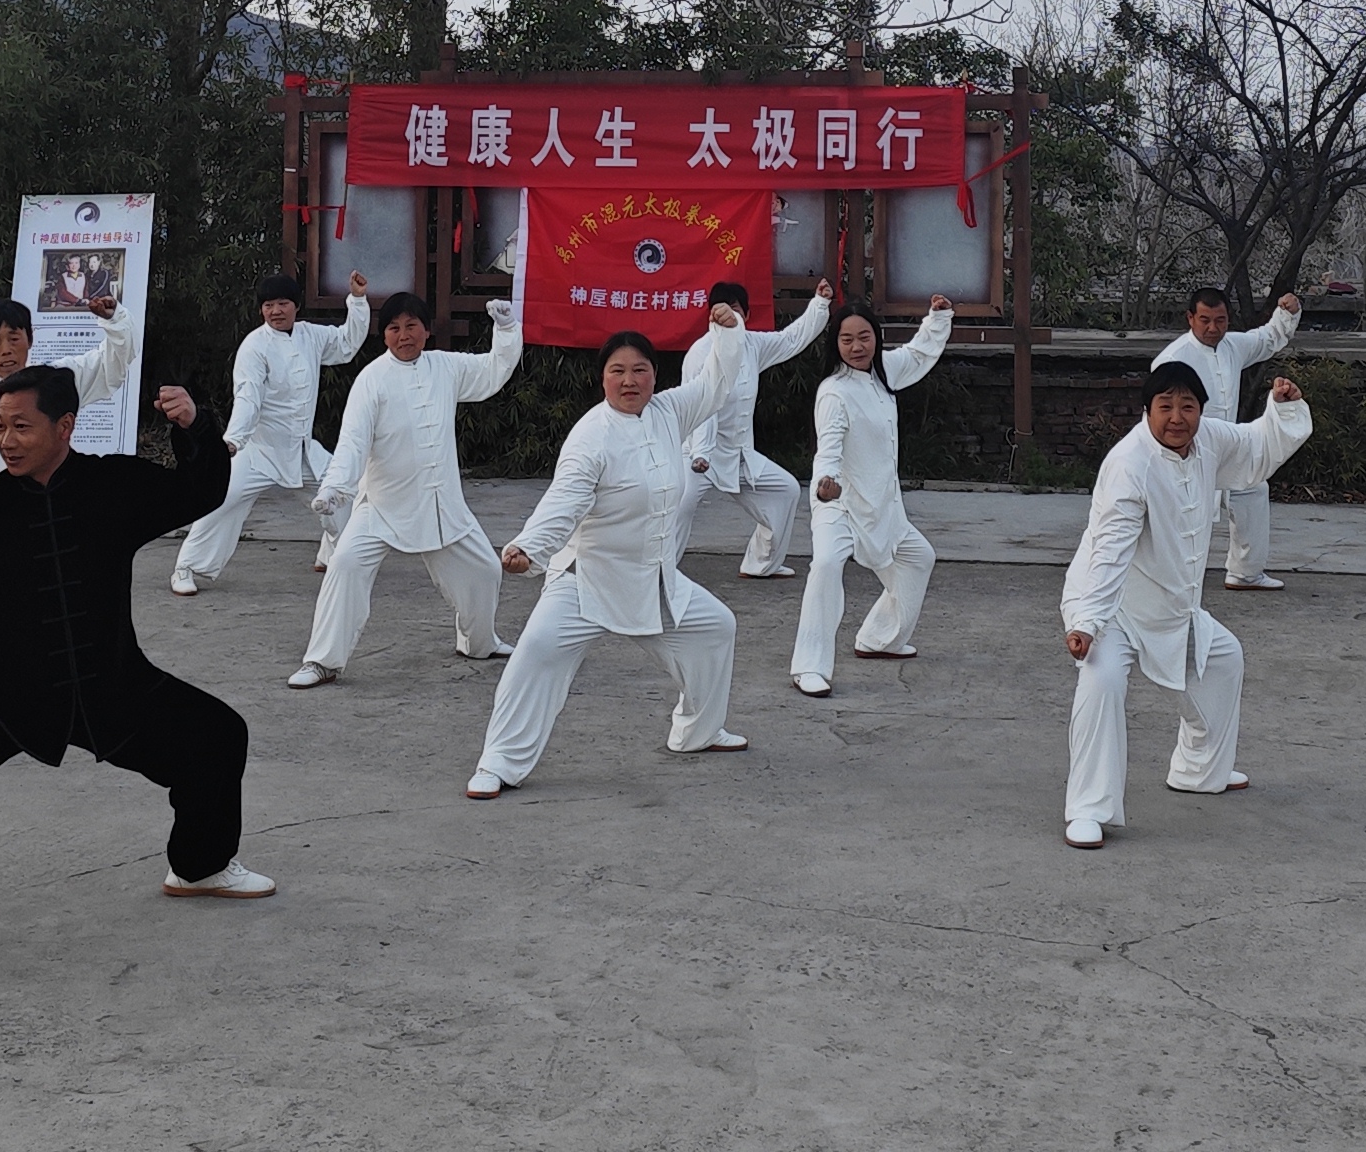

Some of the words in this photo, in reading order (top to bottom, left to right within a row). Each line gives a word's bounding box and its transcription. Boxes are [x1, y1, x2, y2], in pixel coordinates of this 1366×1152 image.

[404, 104, 638, 168] 健康人生
[686, 105, 924, 170] 太极同行
[569, 285, 708, 311] 神垕郗庄村辅导
